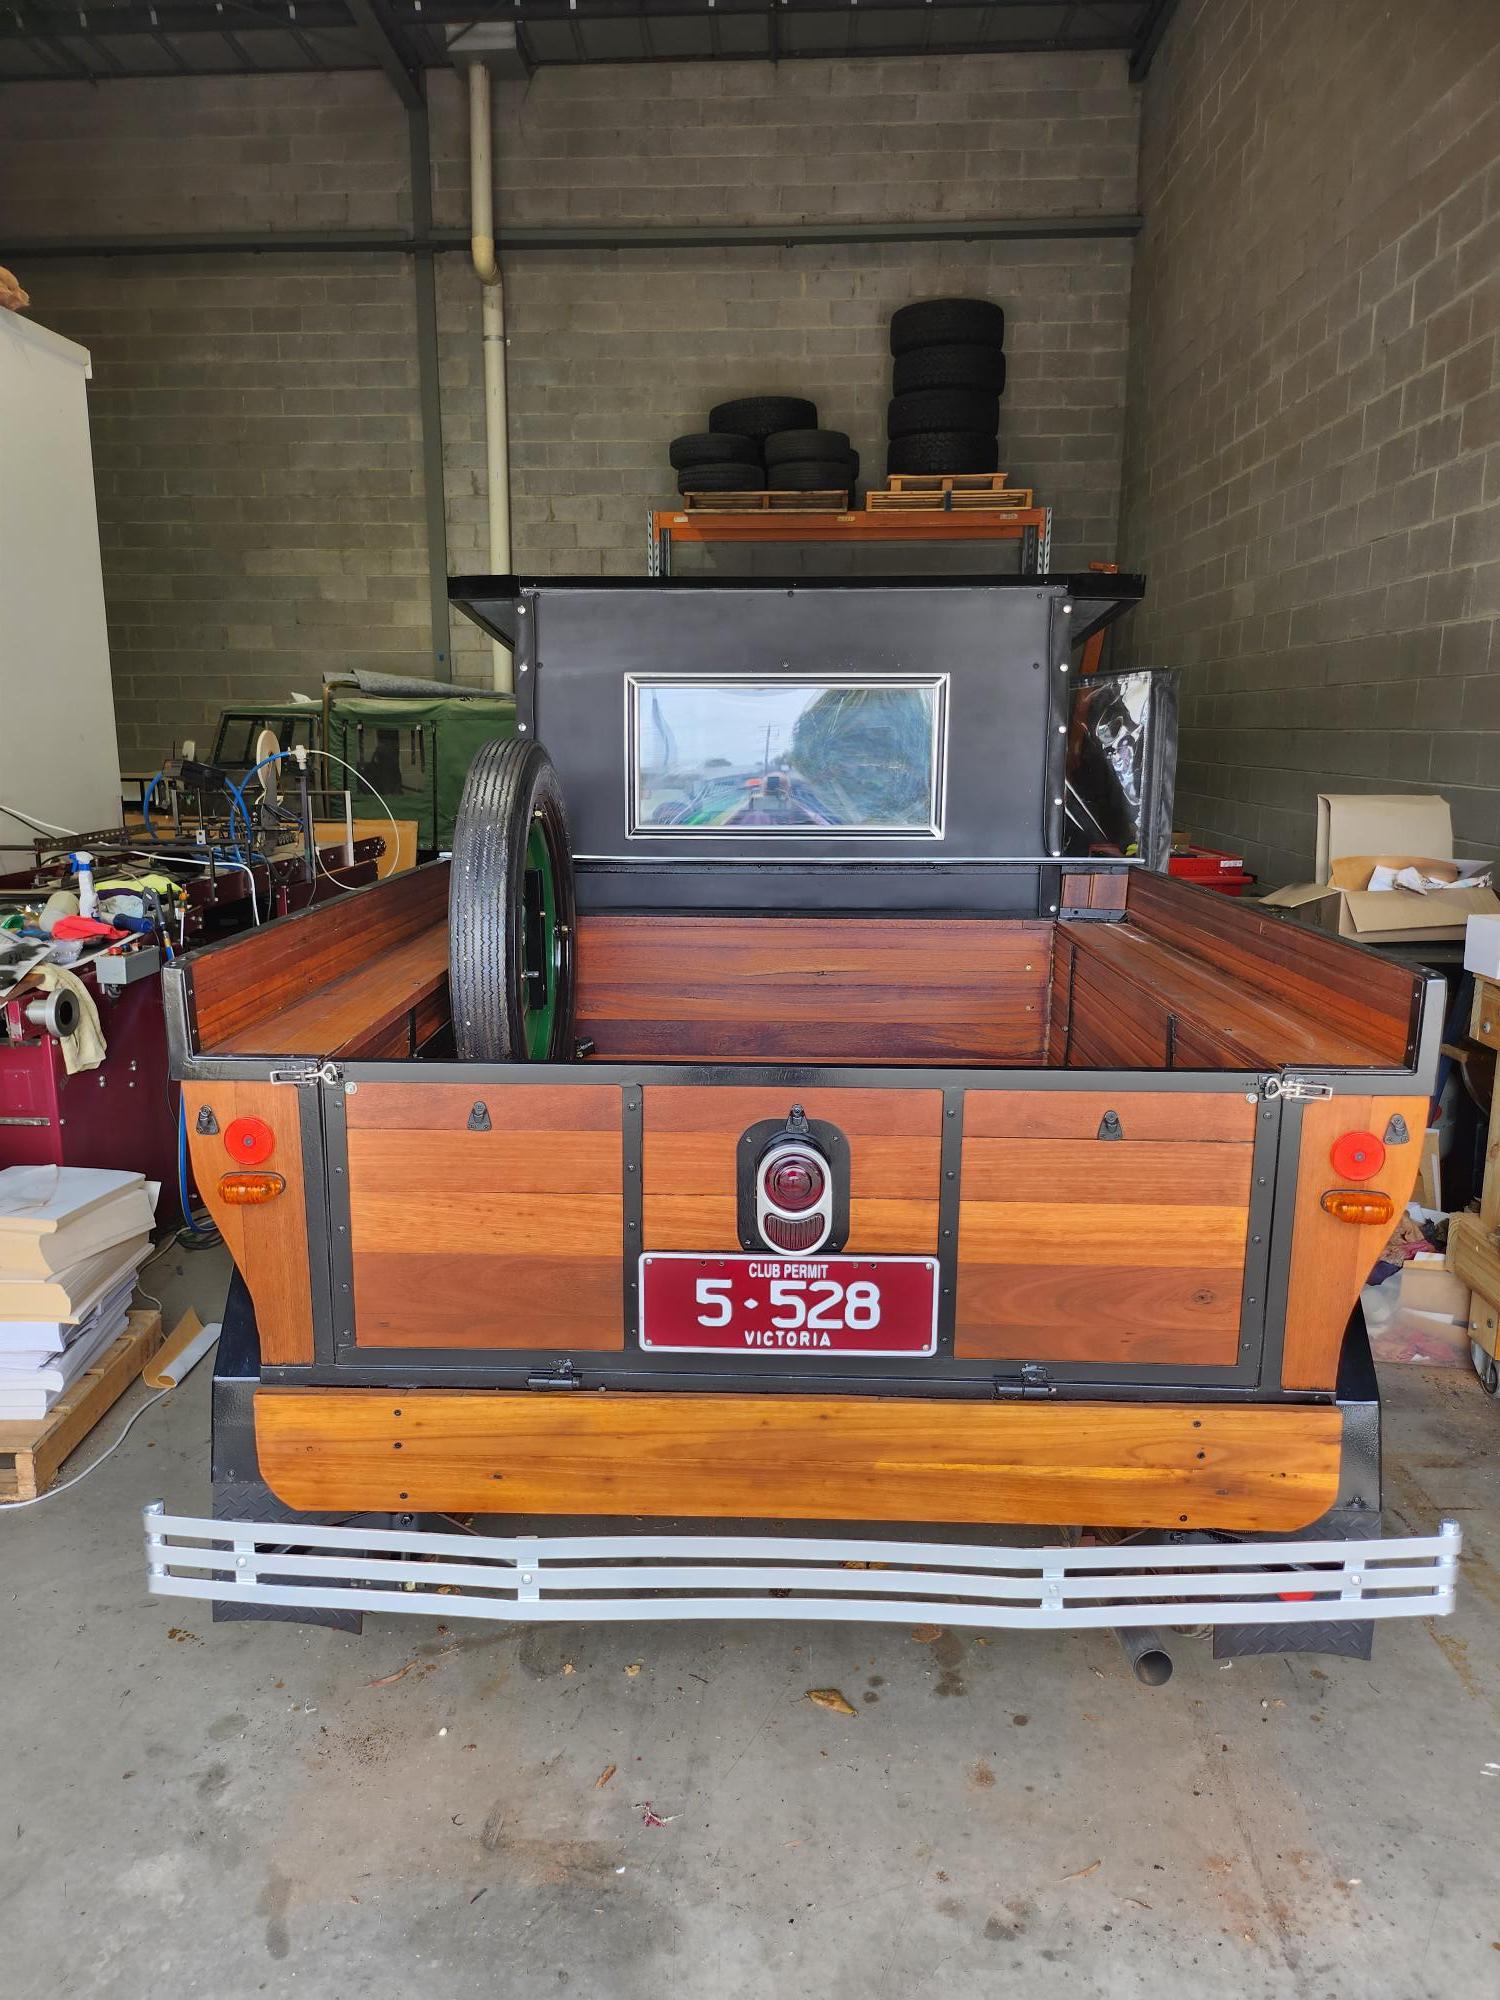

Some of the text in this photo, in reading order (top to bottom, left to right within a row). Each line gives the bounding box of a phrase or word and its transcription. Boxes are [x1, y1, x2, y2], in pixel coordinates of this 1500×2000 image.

[748, 1262, 829, 1279] CLUB PERMIT
[744, 1330, 831, 1347] VICTORIA
